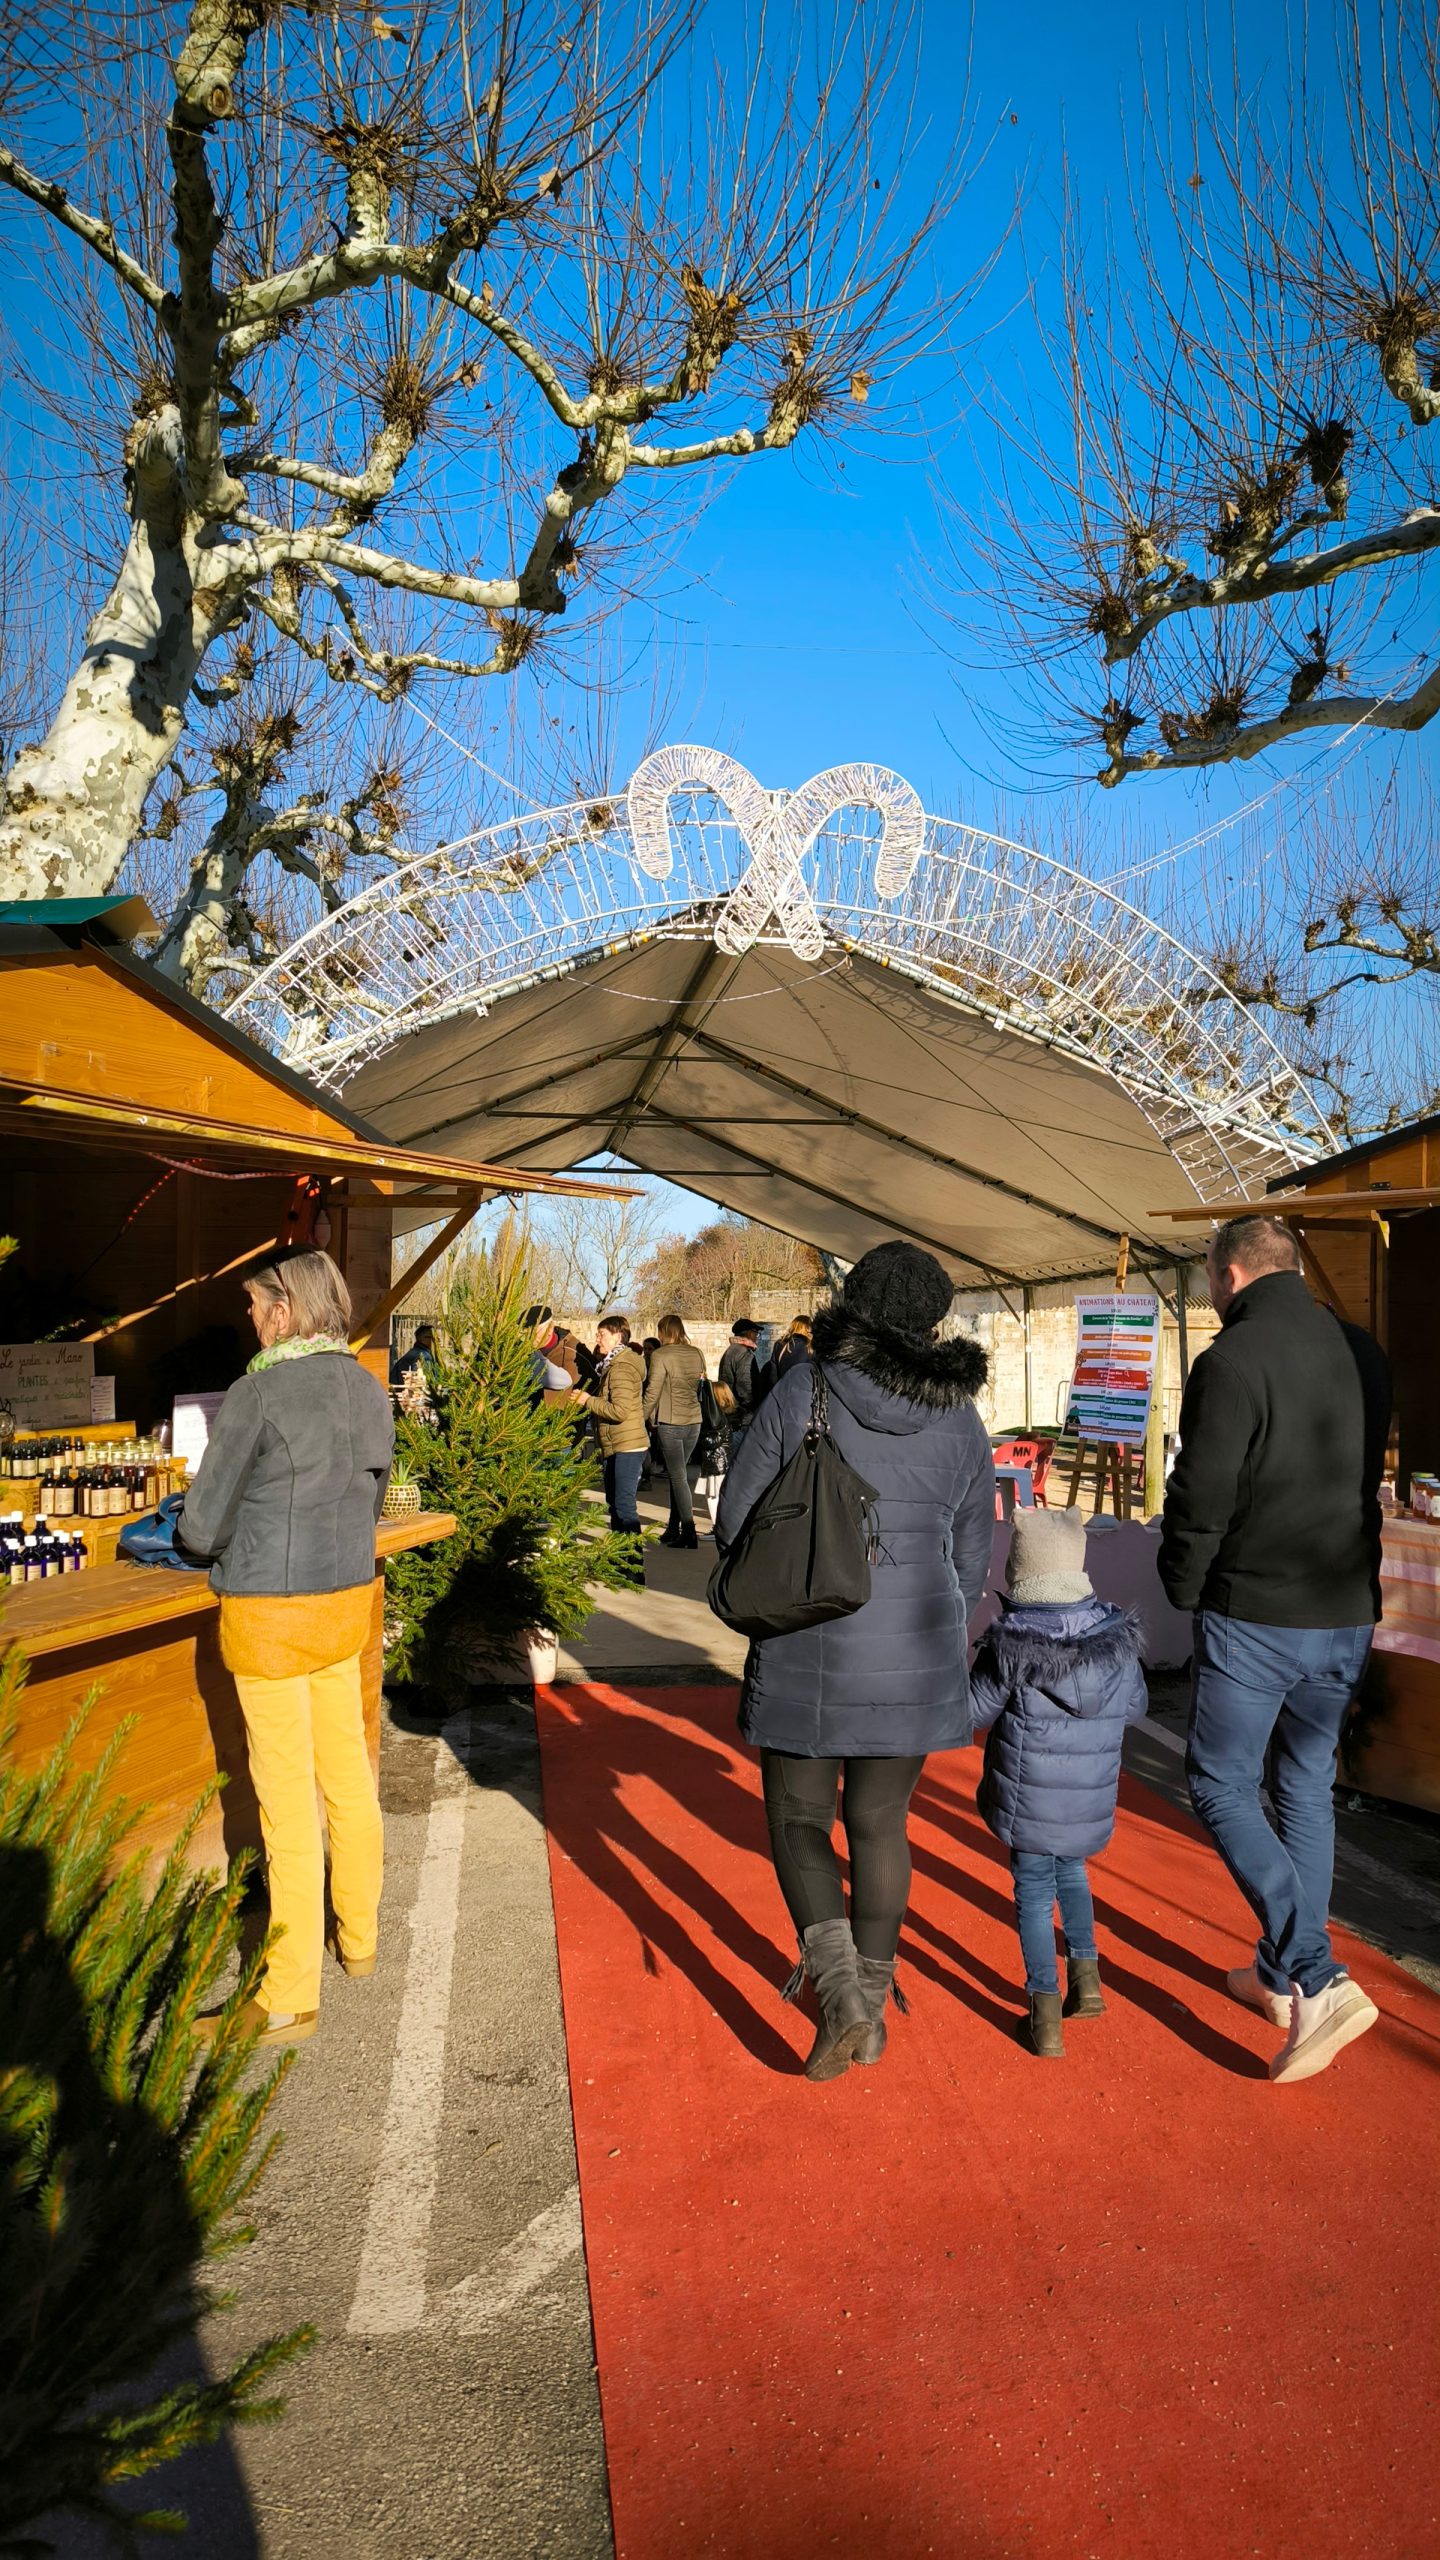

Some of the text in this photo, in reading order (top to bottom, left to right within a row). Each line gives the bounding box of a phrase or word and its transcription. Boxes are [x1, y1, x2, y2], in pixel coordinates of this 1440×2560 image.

[1079, 1297, 1115, 1306] ANIMATIONS
[1117, 1298, 1126, 1306] AU
[0, 1348, 14, 1369] Le
[1012, 1446, 1032, 1457] MN
